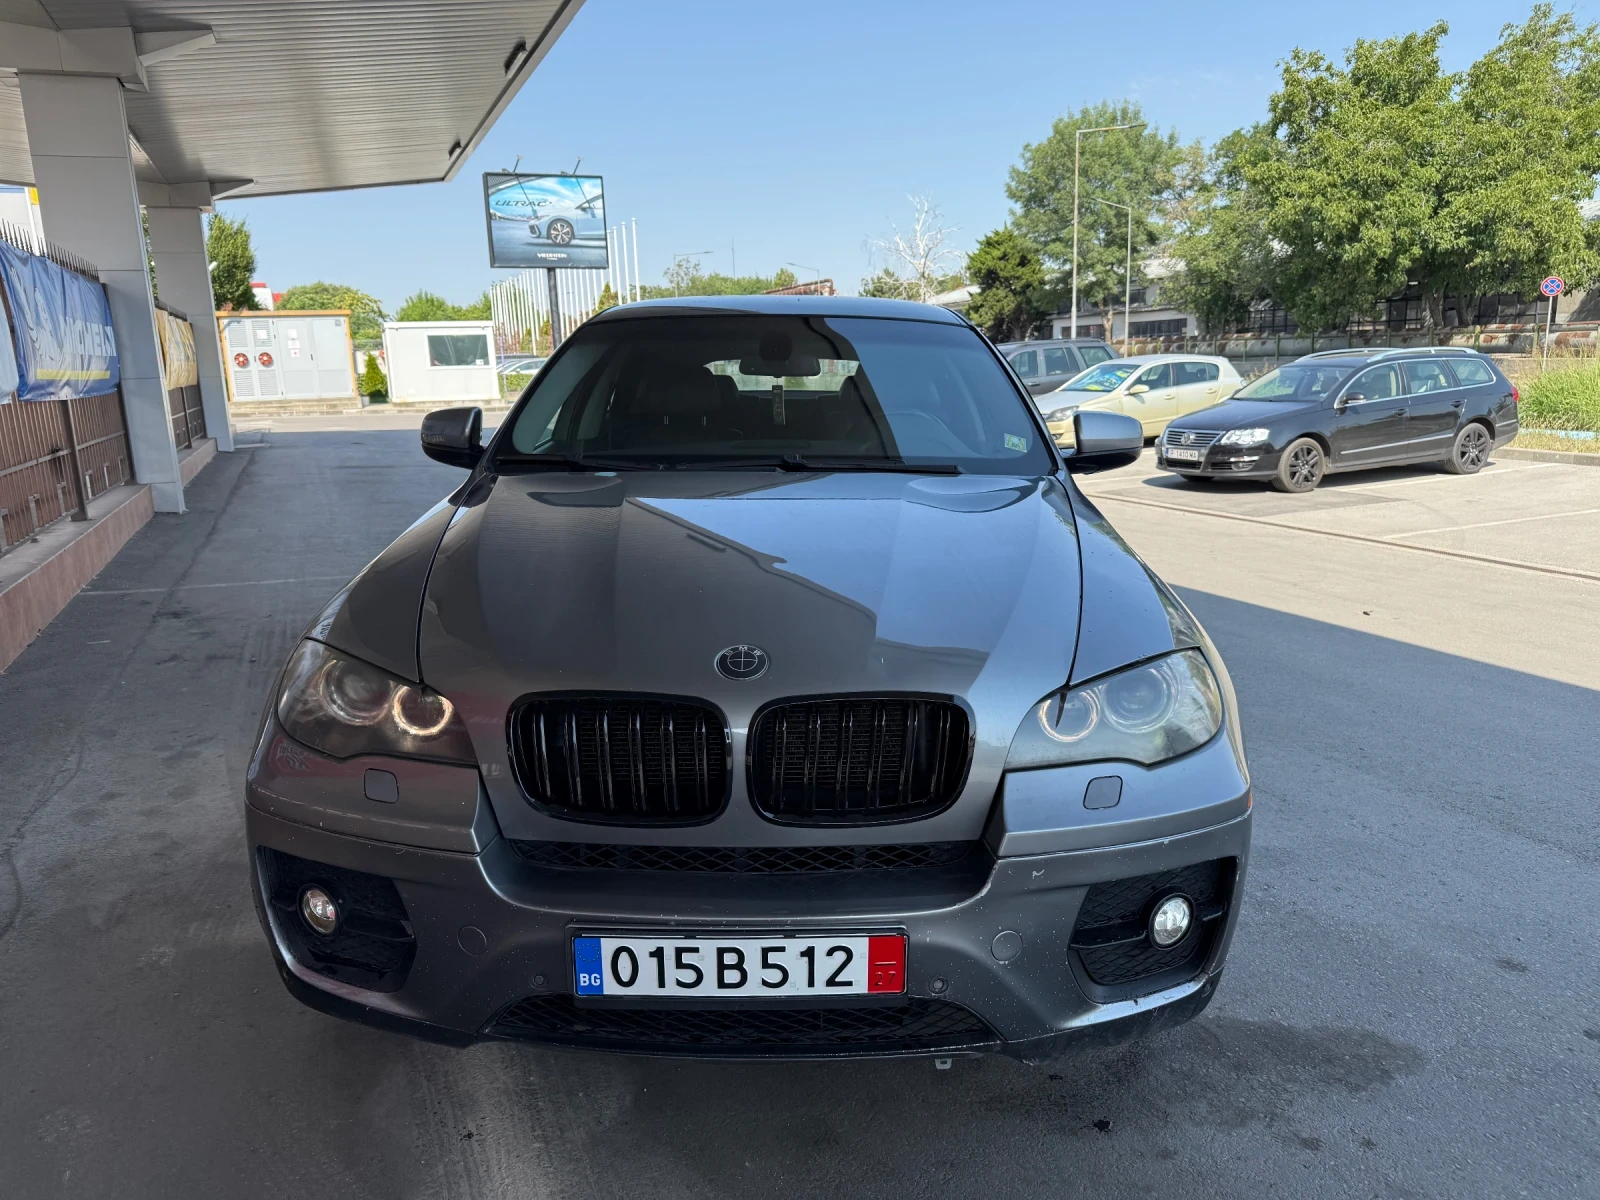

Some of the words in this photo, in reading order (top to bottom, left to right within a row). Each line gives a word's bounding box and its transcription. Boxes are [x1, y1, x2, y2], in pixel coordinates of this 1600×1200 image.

[724, 646, 763, 656] BMW
[579, 973, 601, 987] BG
[874, 971, 896, 986] 27
